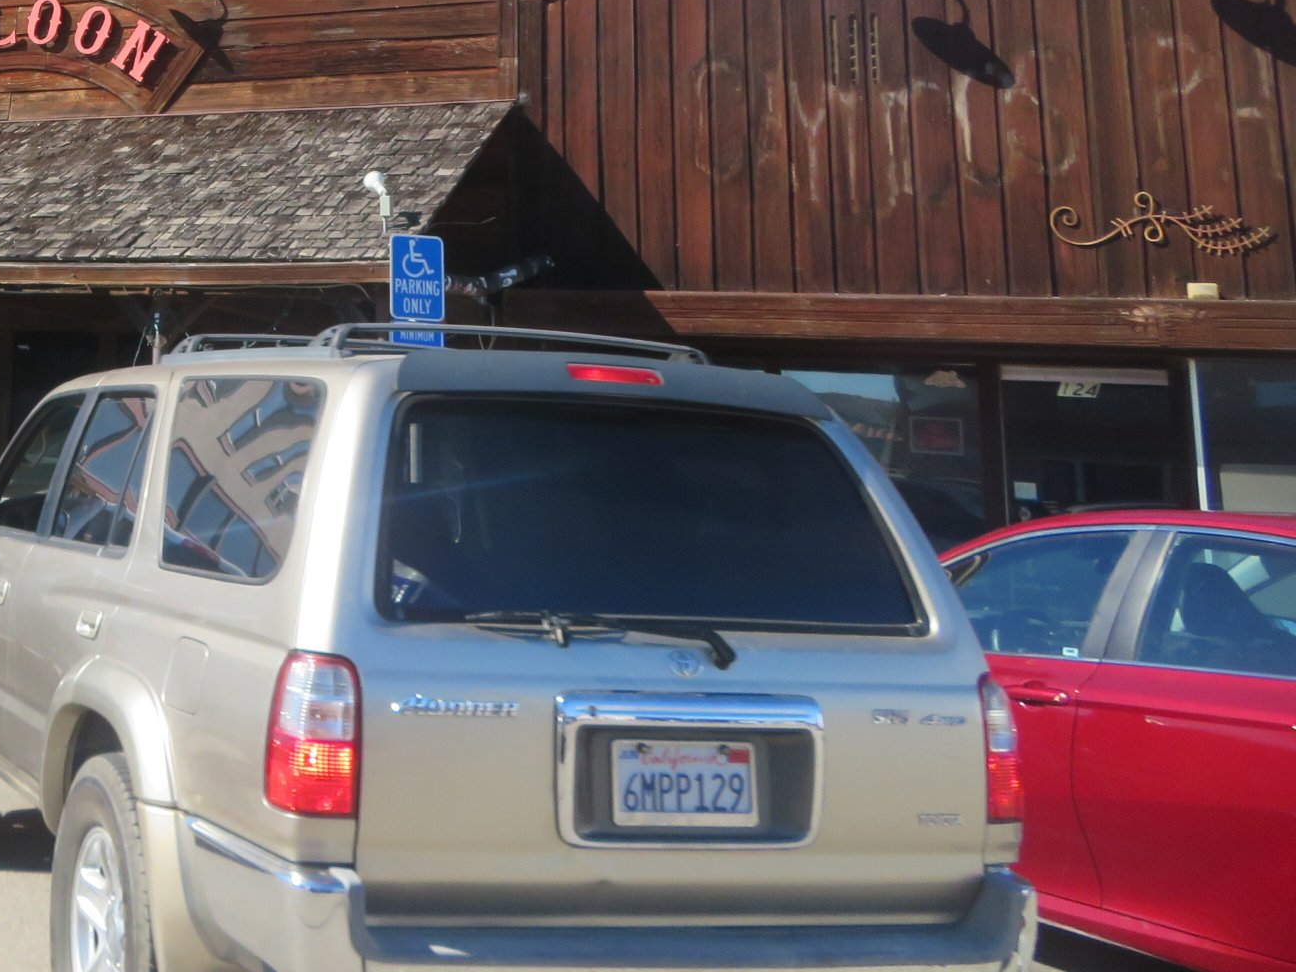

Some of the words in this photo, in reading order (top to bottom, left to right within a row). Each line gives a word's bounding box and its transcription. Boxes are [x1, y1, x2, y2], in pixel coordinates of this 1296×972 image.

[394, 278, 440, 296] PARKING
[402, 297, 433, 315] ONLY
[1062, 382, 1098, 397] 124
[623, 772, 745, 812] 6MPP129
